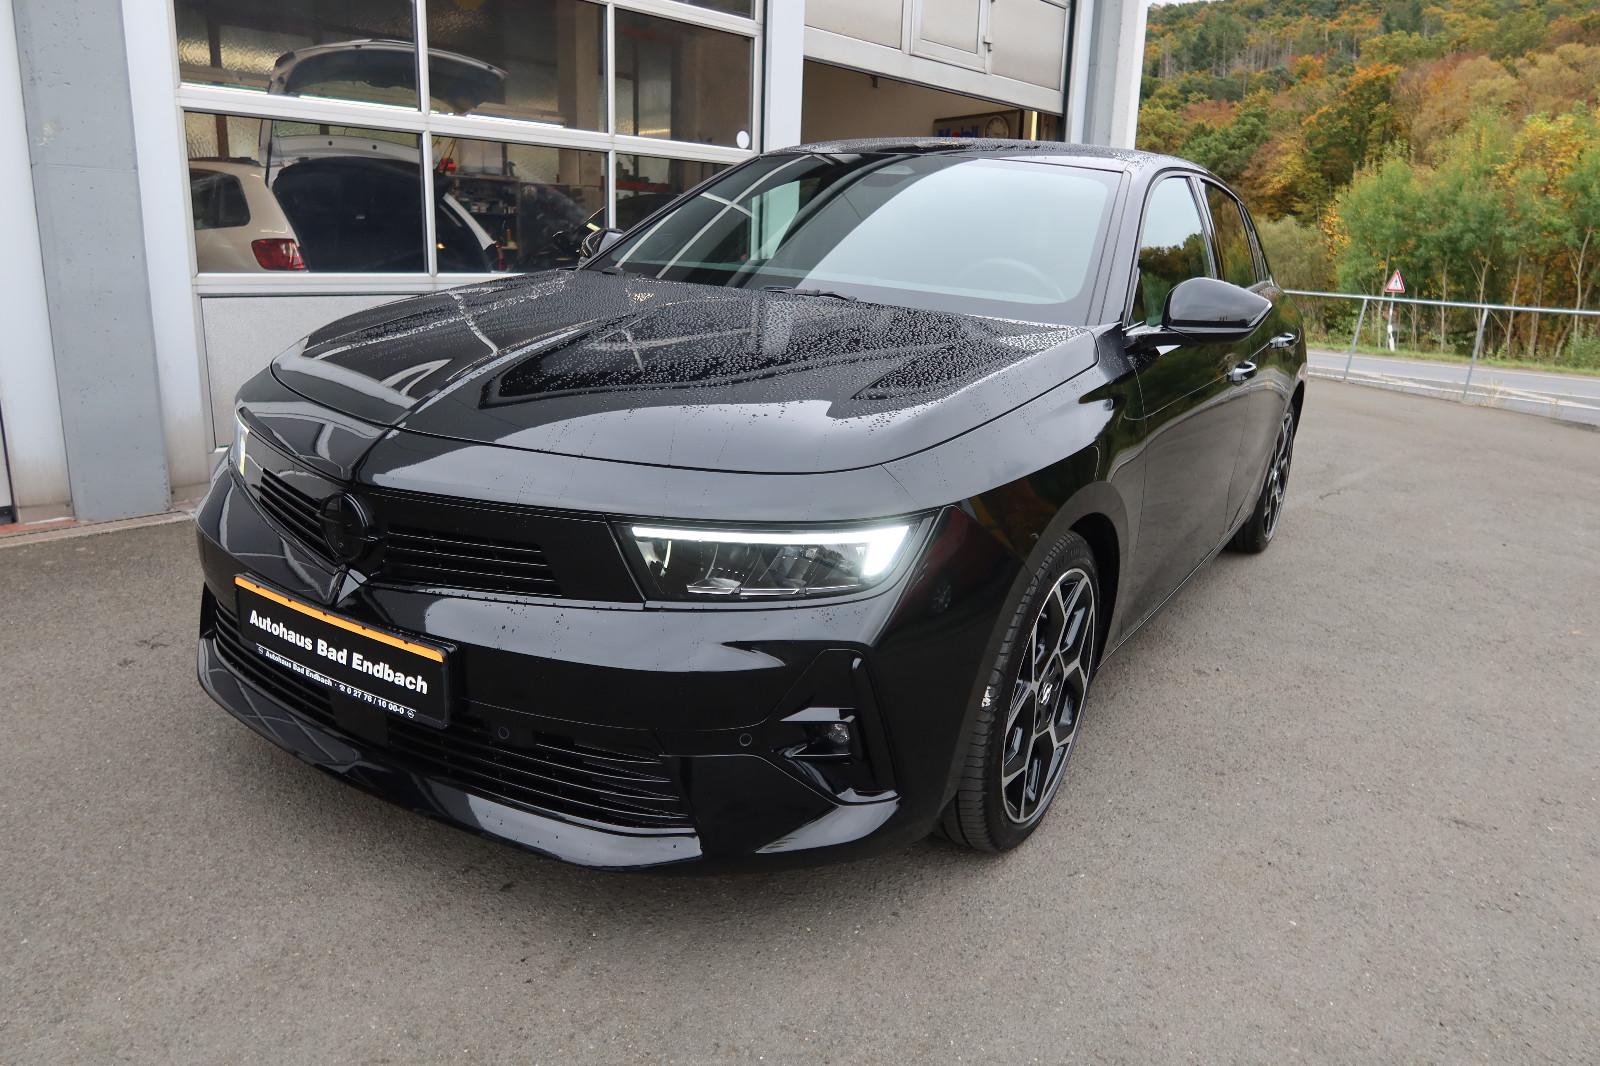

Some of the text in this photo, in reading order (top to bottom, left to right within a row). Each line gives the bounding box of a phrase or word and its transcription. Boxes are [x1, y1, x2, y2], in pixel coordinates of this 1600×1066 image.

[249, 609, 428, 695] Autohaus Bad Endbach
[265, 651, 292, 668] Autohaus
[292, 663, 305, 675] Bad
[305, 668, 333, 687] Endbach
[353, 689, 362, 698] 27
[378, 699, 387, 708] 10
